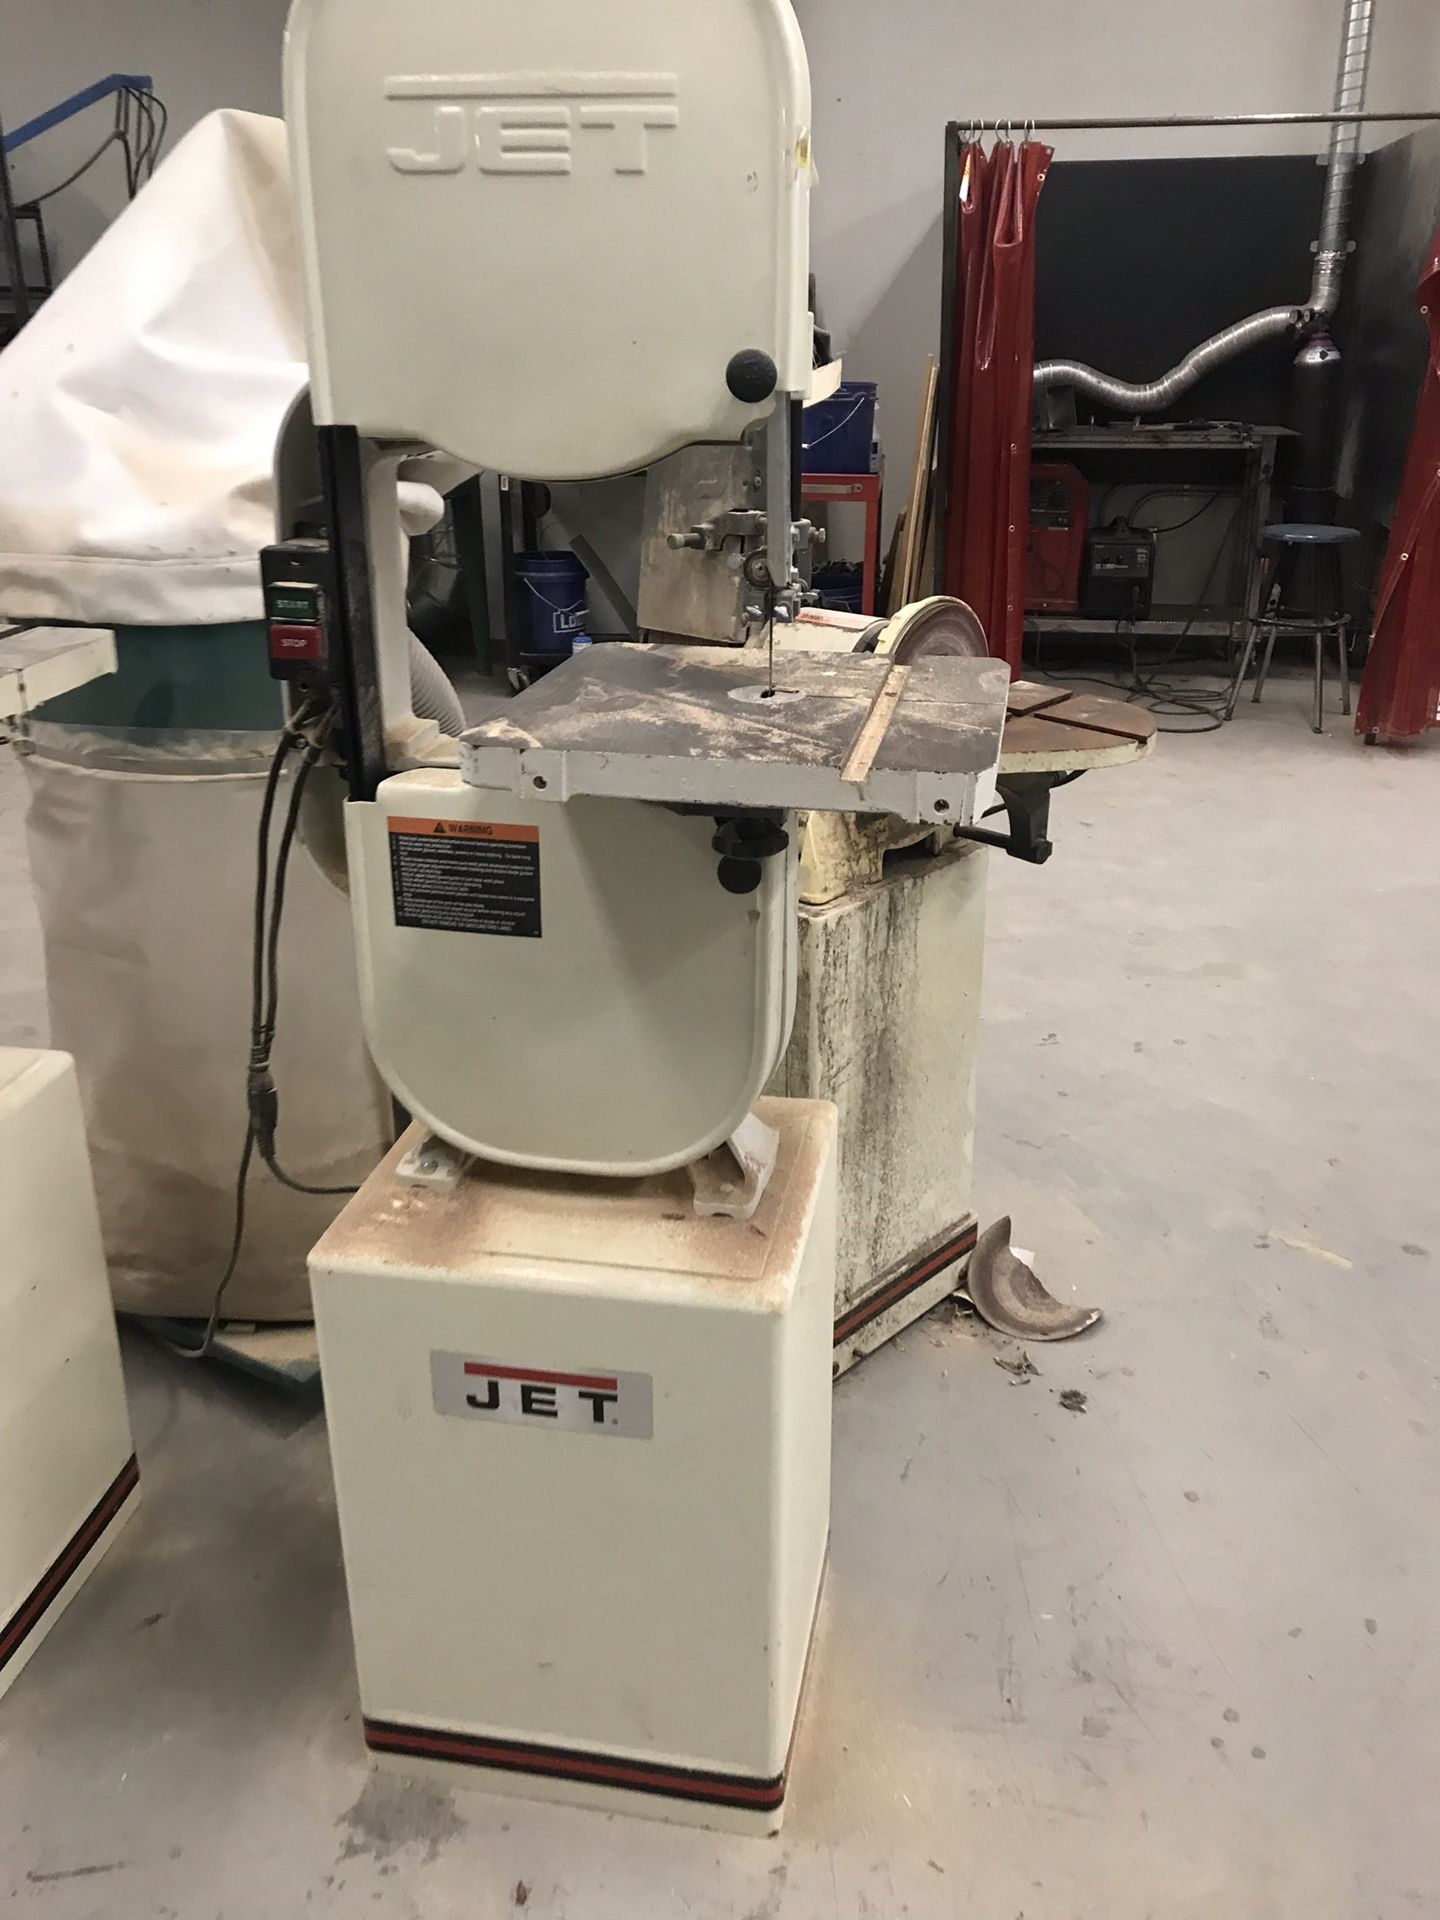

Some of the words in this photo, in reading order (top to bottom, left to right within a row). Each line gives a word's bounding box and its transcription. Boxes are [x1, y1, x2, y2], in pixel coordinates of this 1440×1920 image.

[386, 104, 679, 176] JET
[276, 599, 309, 609] START
[280, 638, 306, 647] STOP
[448, 823, 493, 835] WARNING
[466, 1380, 618, 1423] JET
